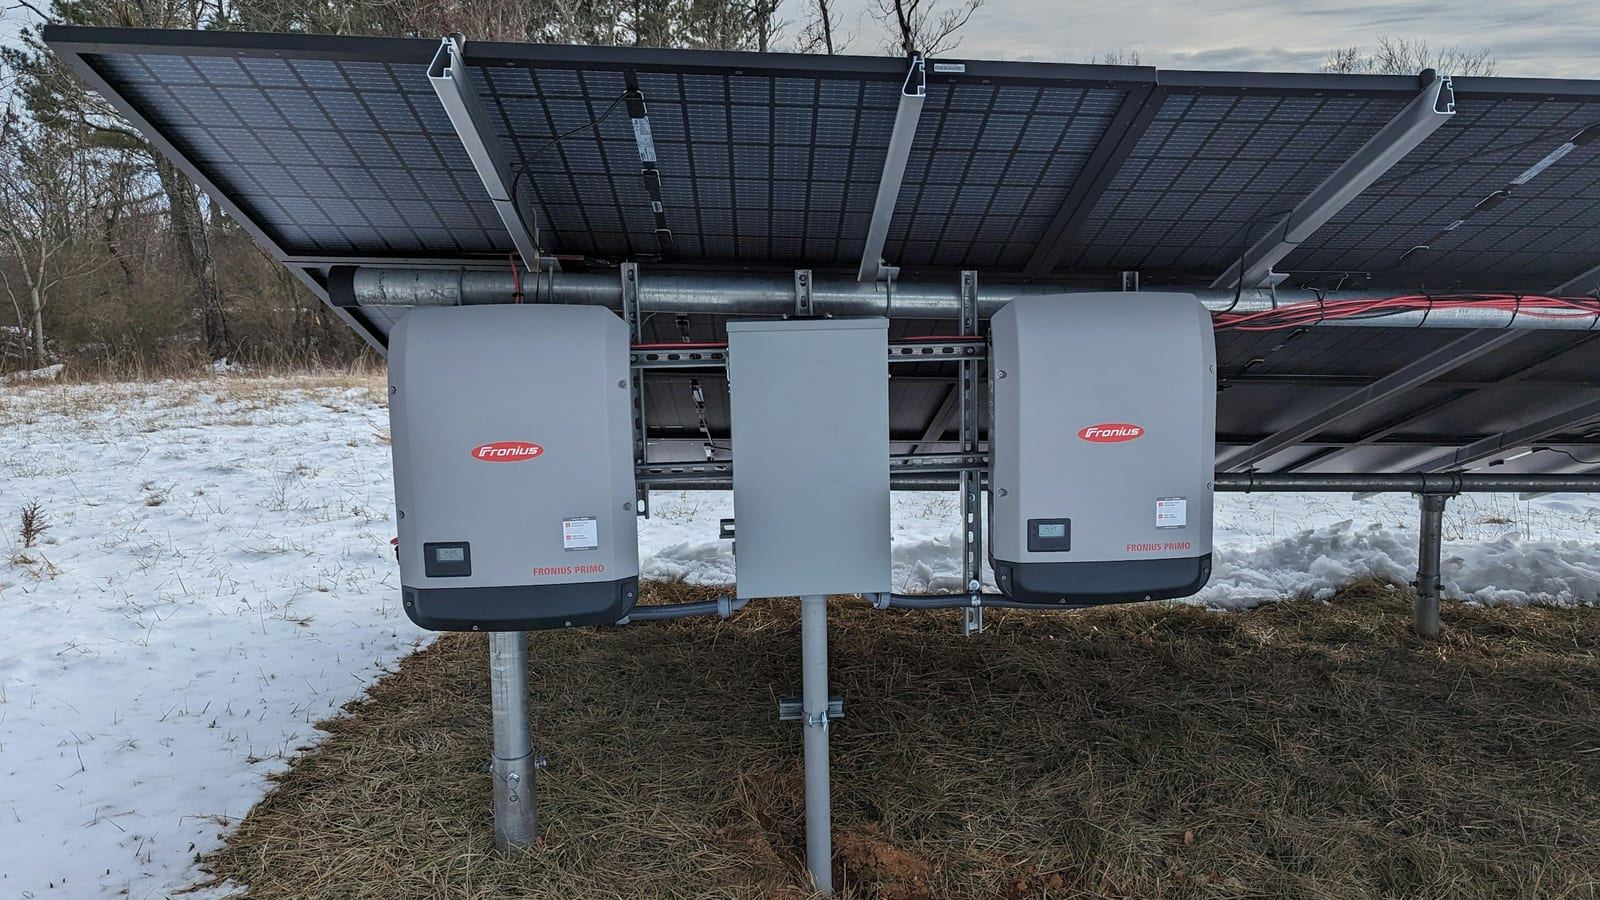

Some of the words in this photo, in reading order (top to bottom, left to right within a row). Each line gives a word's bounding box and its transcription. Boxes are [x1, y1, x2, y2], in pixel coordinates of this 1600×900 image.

[1085, 427, 1140, 438] Fronius
[479, 446, 538, 457] Fronius
[1126, 543, 1162, 552] FRONIUS
[1164, 542, 1191, 551] PRIMO
[533, 566, 572, 576] FRONIUS
[574, 565, 604, 574] PRIMO
